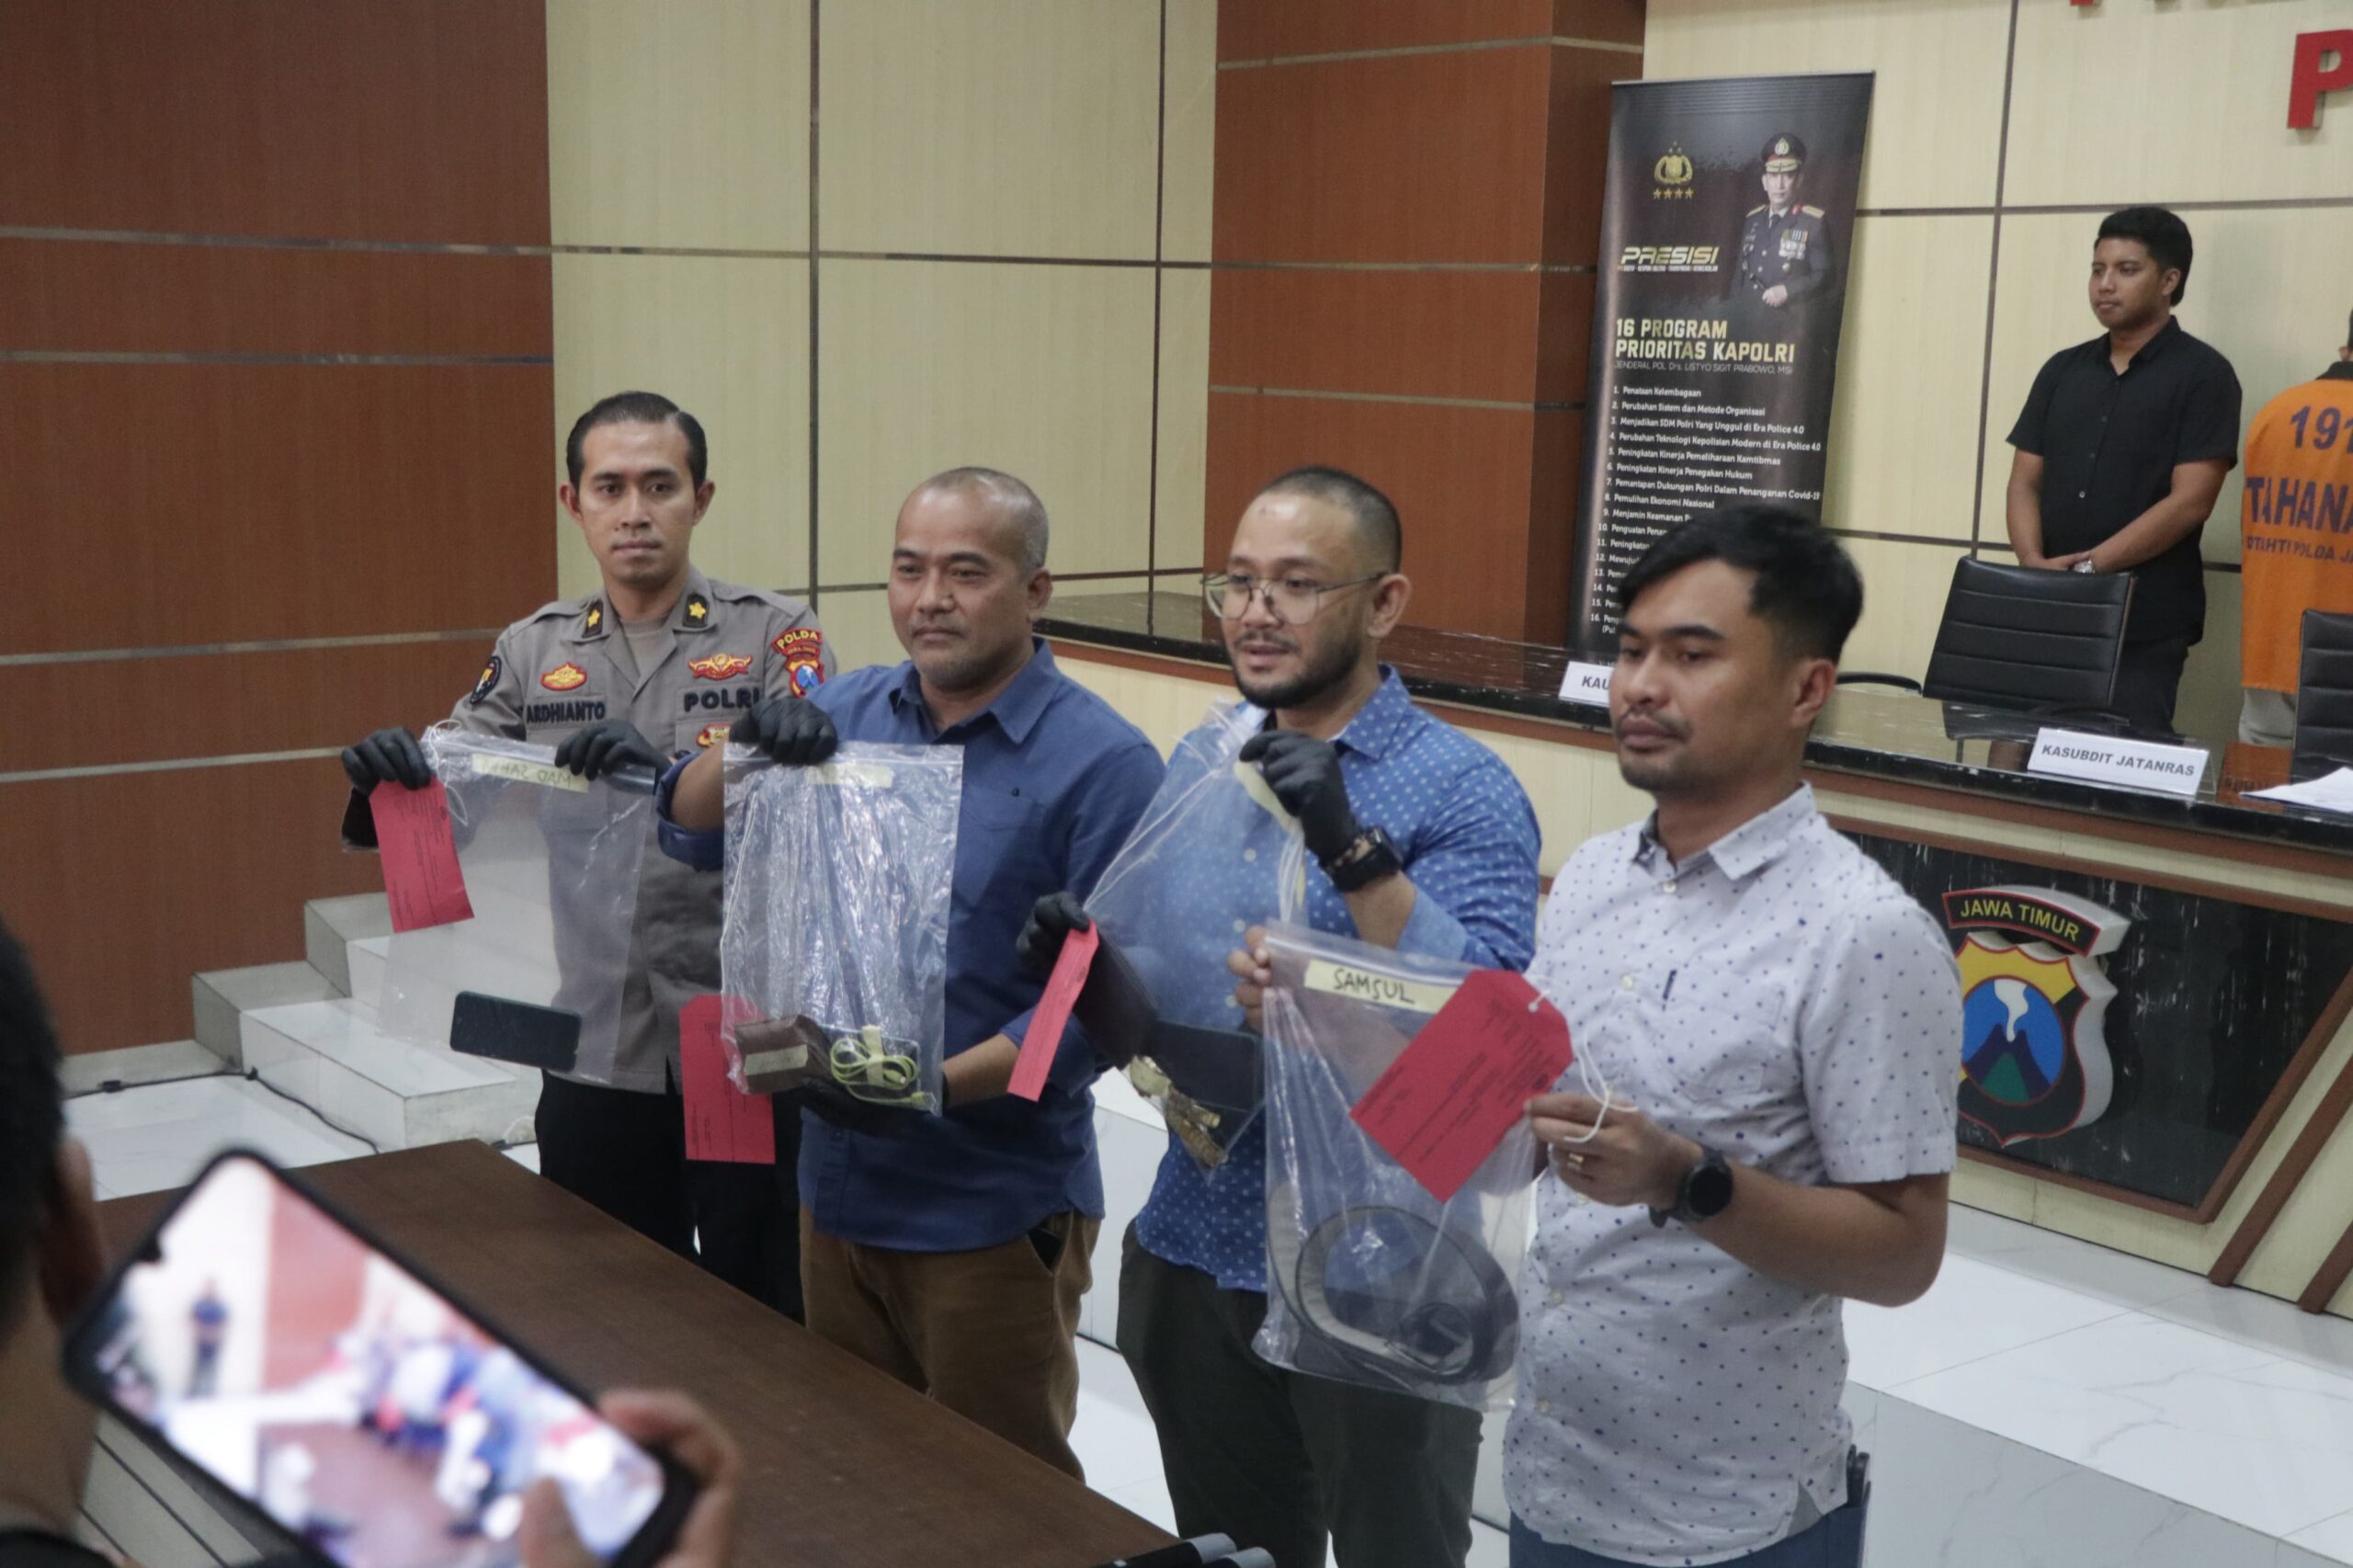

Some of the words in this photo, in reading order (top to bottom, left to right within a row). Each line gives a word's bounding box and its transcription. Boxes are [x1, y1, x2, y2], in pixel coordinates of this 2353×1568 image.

[1620, 245, 1720, 265] PRESISI
[1616, 318, 1634, 337] 16
[1641, 319, 1727, 339] PROGRAM
[1615, 339, 1706, 359] PRIORITAS
[1712, 342, 1795, 363] KAPOLRI
[1614, 360, 1651, 369] JENDERAL
[1623, 386, 1653, 395] Penataan
[1654, 387, 1701, 398] Kelembagaan
[1622, 402, 1657, 411] Perubahan
[1658, 403, 1680, 412] Sistem
[1682, 404, 1696, 413] dan
[1698, 405, 1723, 414] Metode
[1725, 405, 1765, 416] Organisasi
[1620, 416, 1659, 427] Menjadikan
[1660, 418, 1675, 427] SDM
[1677, 419, 1693, 428] Polri
[1695, 421, 1713, 431] Yang
[1714, 422, 1742, 432] Unggul
[1744, 423, 1751, 431] di
[1753, 424, 1765, 432] Era
[1768, 424, 1791, 433] Police
[1793, 426, 1804, 434] 4.0
[1620, 432, 1654, 442] Perubahan
[1655, 434, 1690, 445] Teknologi
[1692, 436, 1730, 447] Kepolisian
[1732, 438, 1761, 449] Modern
[1763, 439, 1770, 449] di
[1773, 441, 1785, 449] Era
[1787, 442, 1810, 450] Police
[1812, 443, 1821, 451] 4.0
[1618, 448, 1658, 459] Peningkatan
[1659, 450, 1685, 460] Kinerja
[1686, 451, 1735, 462] Pemeliharaan
[1737, 454, 1780, 465] Kamtibmas
[1617, 462, 1656, 474] Peningkatan
[1658, 465, 1683, 476] Kinerja
[1685, 467, 1723, 478] Penegakan
[1725, 470, 1753, 480] Hukum
[1616, 478, 1654, 489] Pemantapan
[1657, 481, 1694, 493] Dukungan
[1696, 483, 1712, 493] Polri
[1714, 485, 1737, 494] Dalam
[1739, 486, 1787, 498] Penanganan
[1789, 489, 1820, 500] Covid-19
[1614, 494, 1649, 504] Pemulihan
[1650, 496, 1681, 506] Ekonomi
[1683, 499, 1714, 508] Nasional
[1612, 508, 1645, 519] Menjamin
[1647, 511, 1683, 522] Keamanan
[1611, 524, 1645, 535] Penguatan
[777, 631, 818, 650] POLDA
[684, 687, 760, 712] POLRI
[2041, 744, 2114, 766] KASUBDIT
[2116, 755, 2195, 777] JATANRAS
[1961, 899, 2013, 918] JAWA
[2018, 903, 2080, 942] TIMUR
[1334, 968, 1415, 1004] SAMSUL
